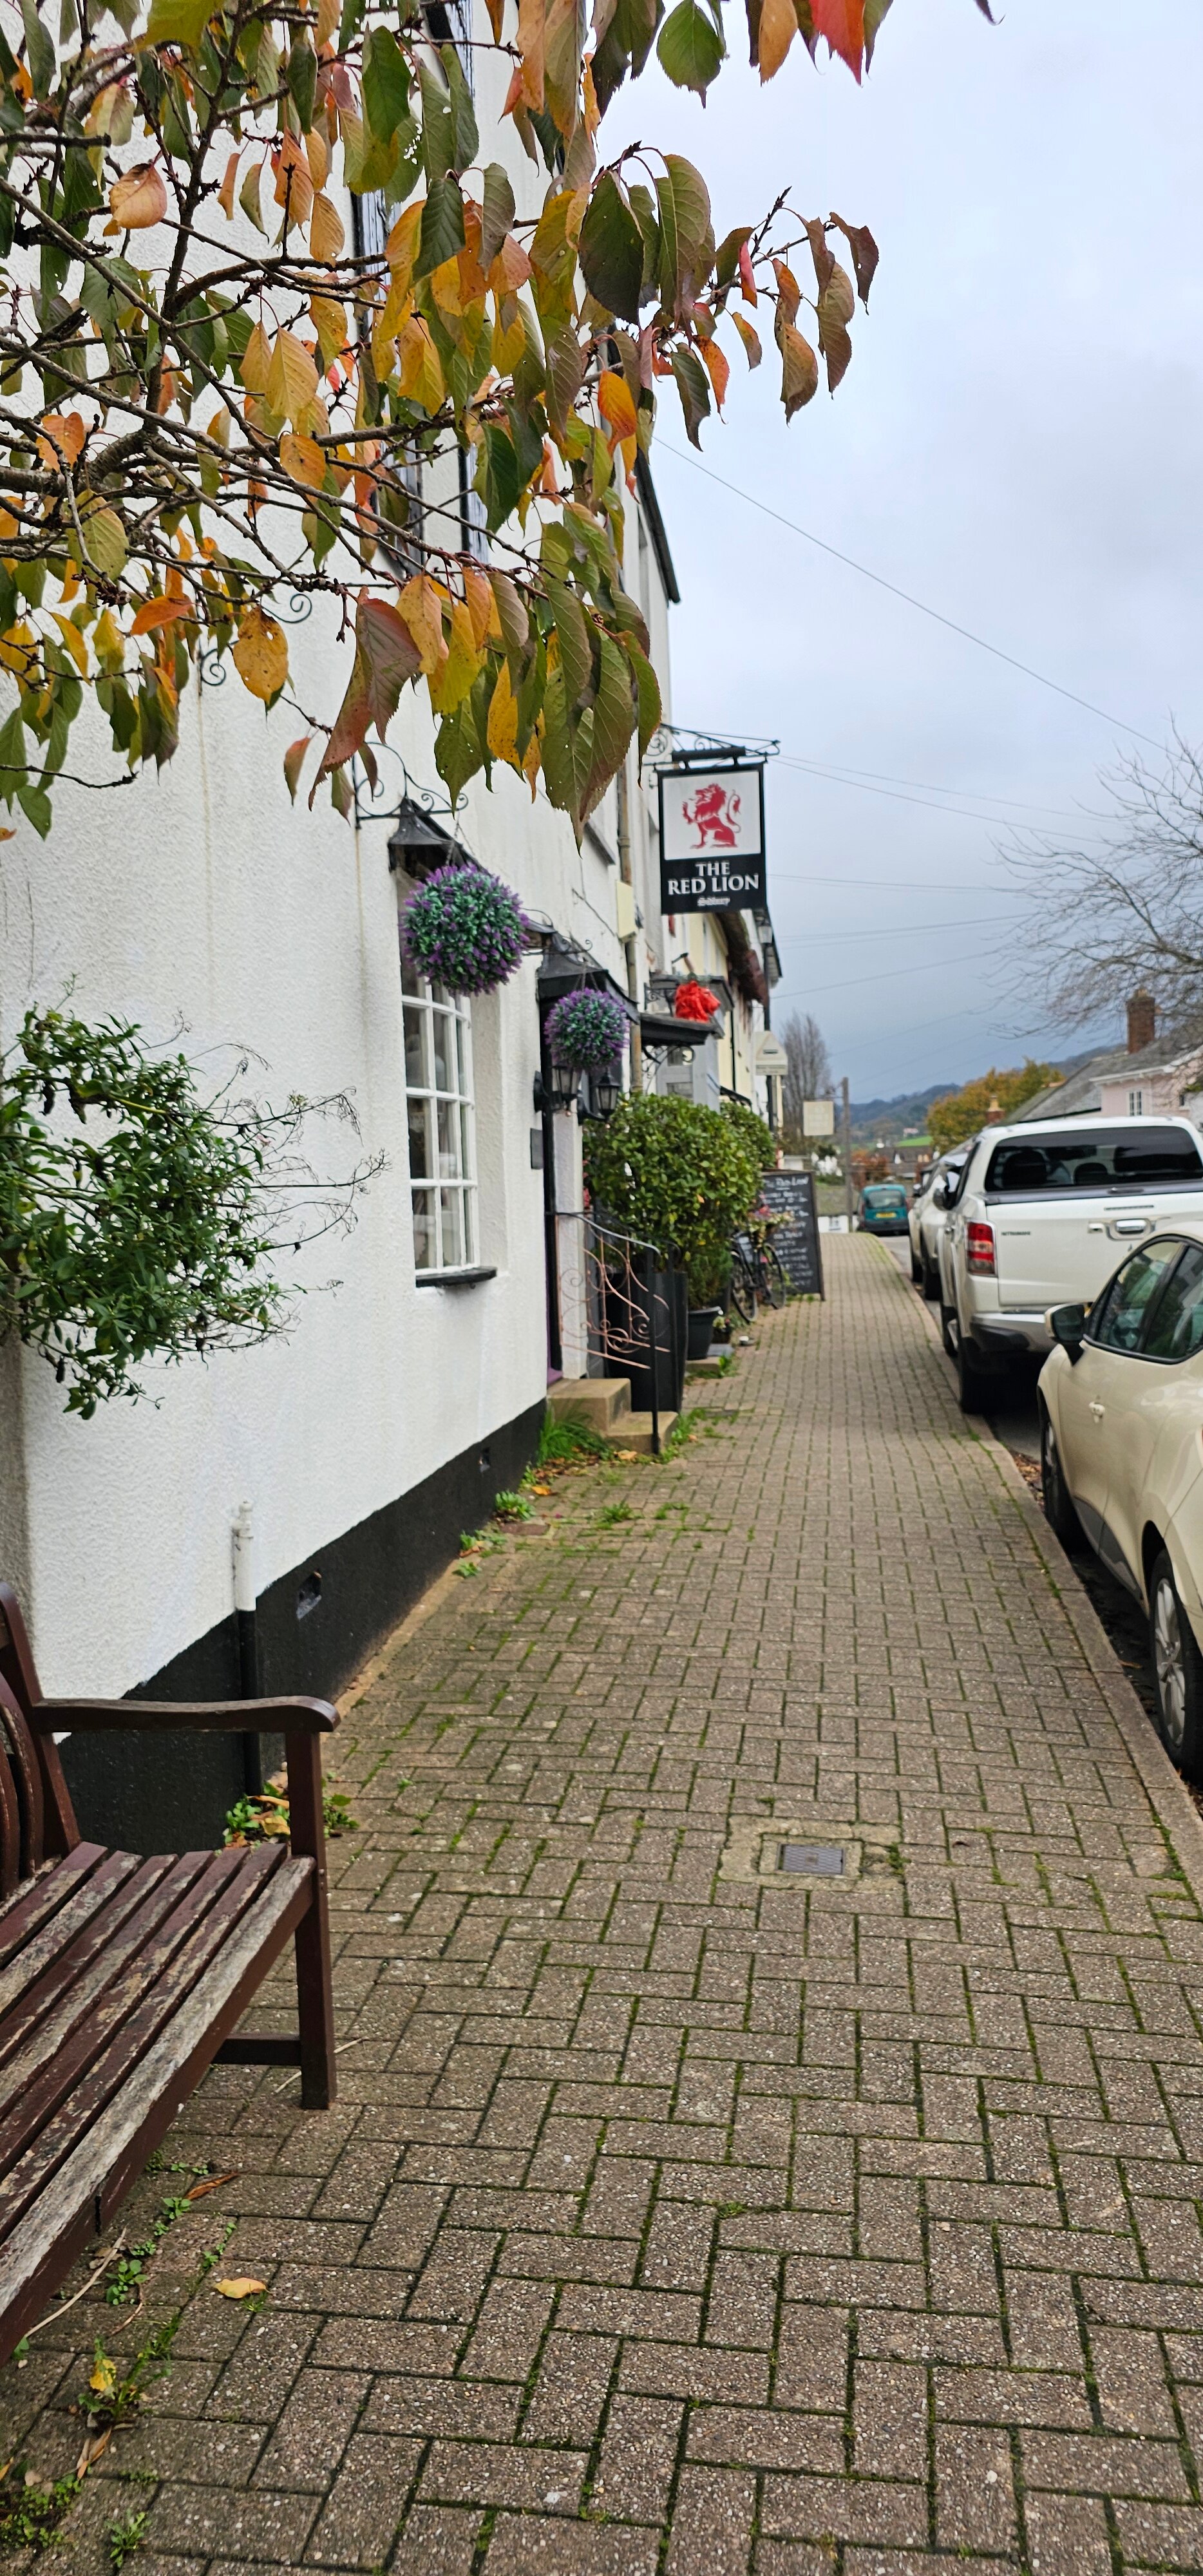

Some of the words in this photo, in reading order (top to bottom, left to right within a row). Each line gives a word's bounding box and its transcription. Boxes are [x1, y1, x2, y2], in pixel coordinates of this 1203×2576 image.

[696, 862, 730, 876] THE
[668, 878, 706, 895] RED
[712, 873, 759, 892] LION
